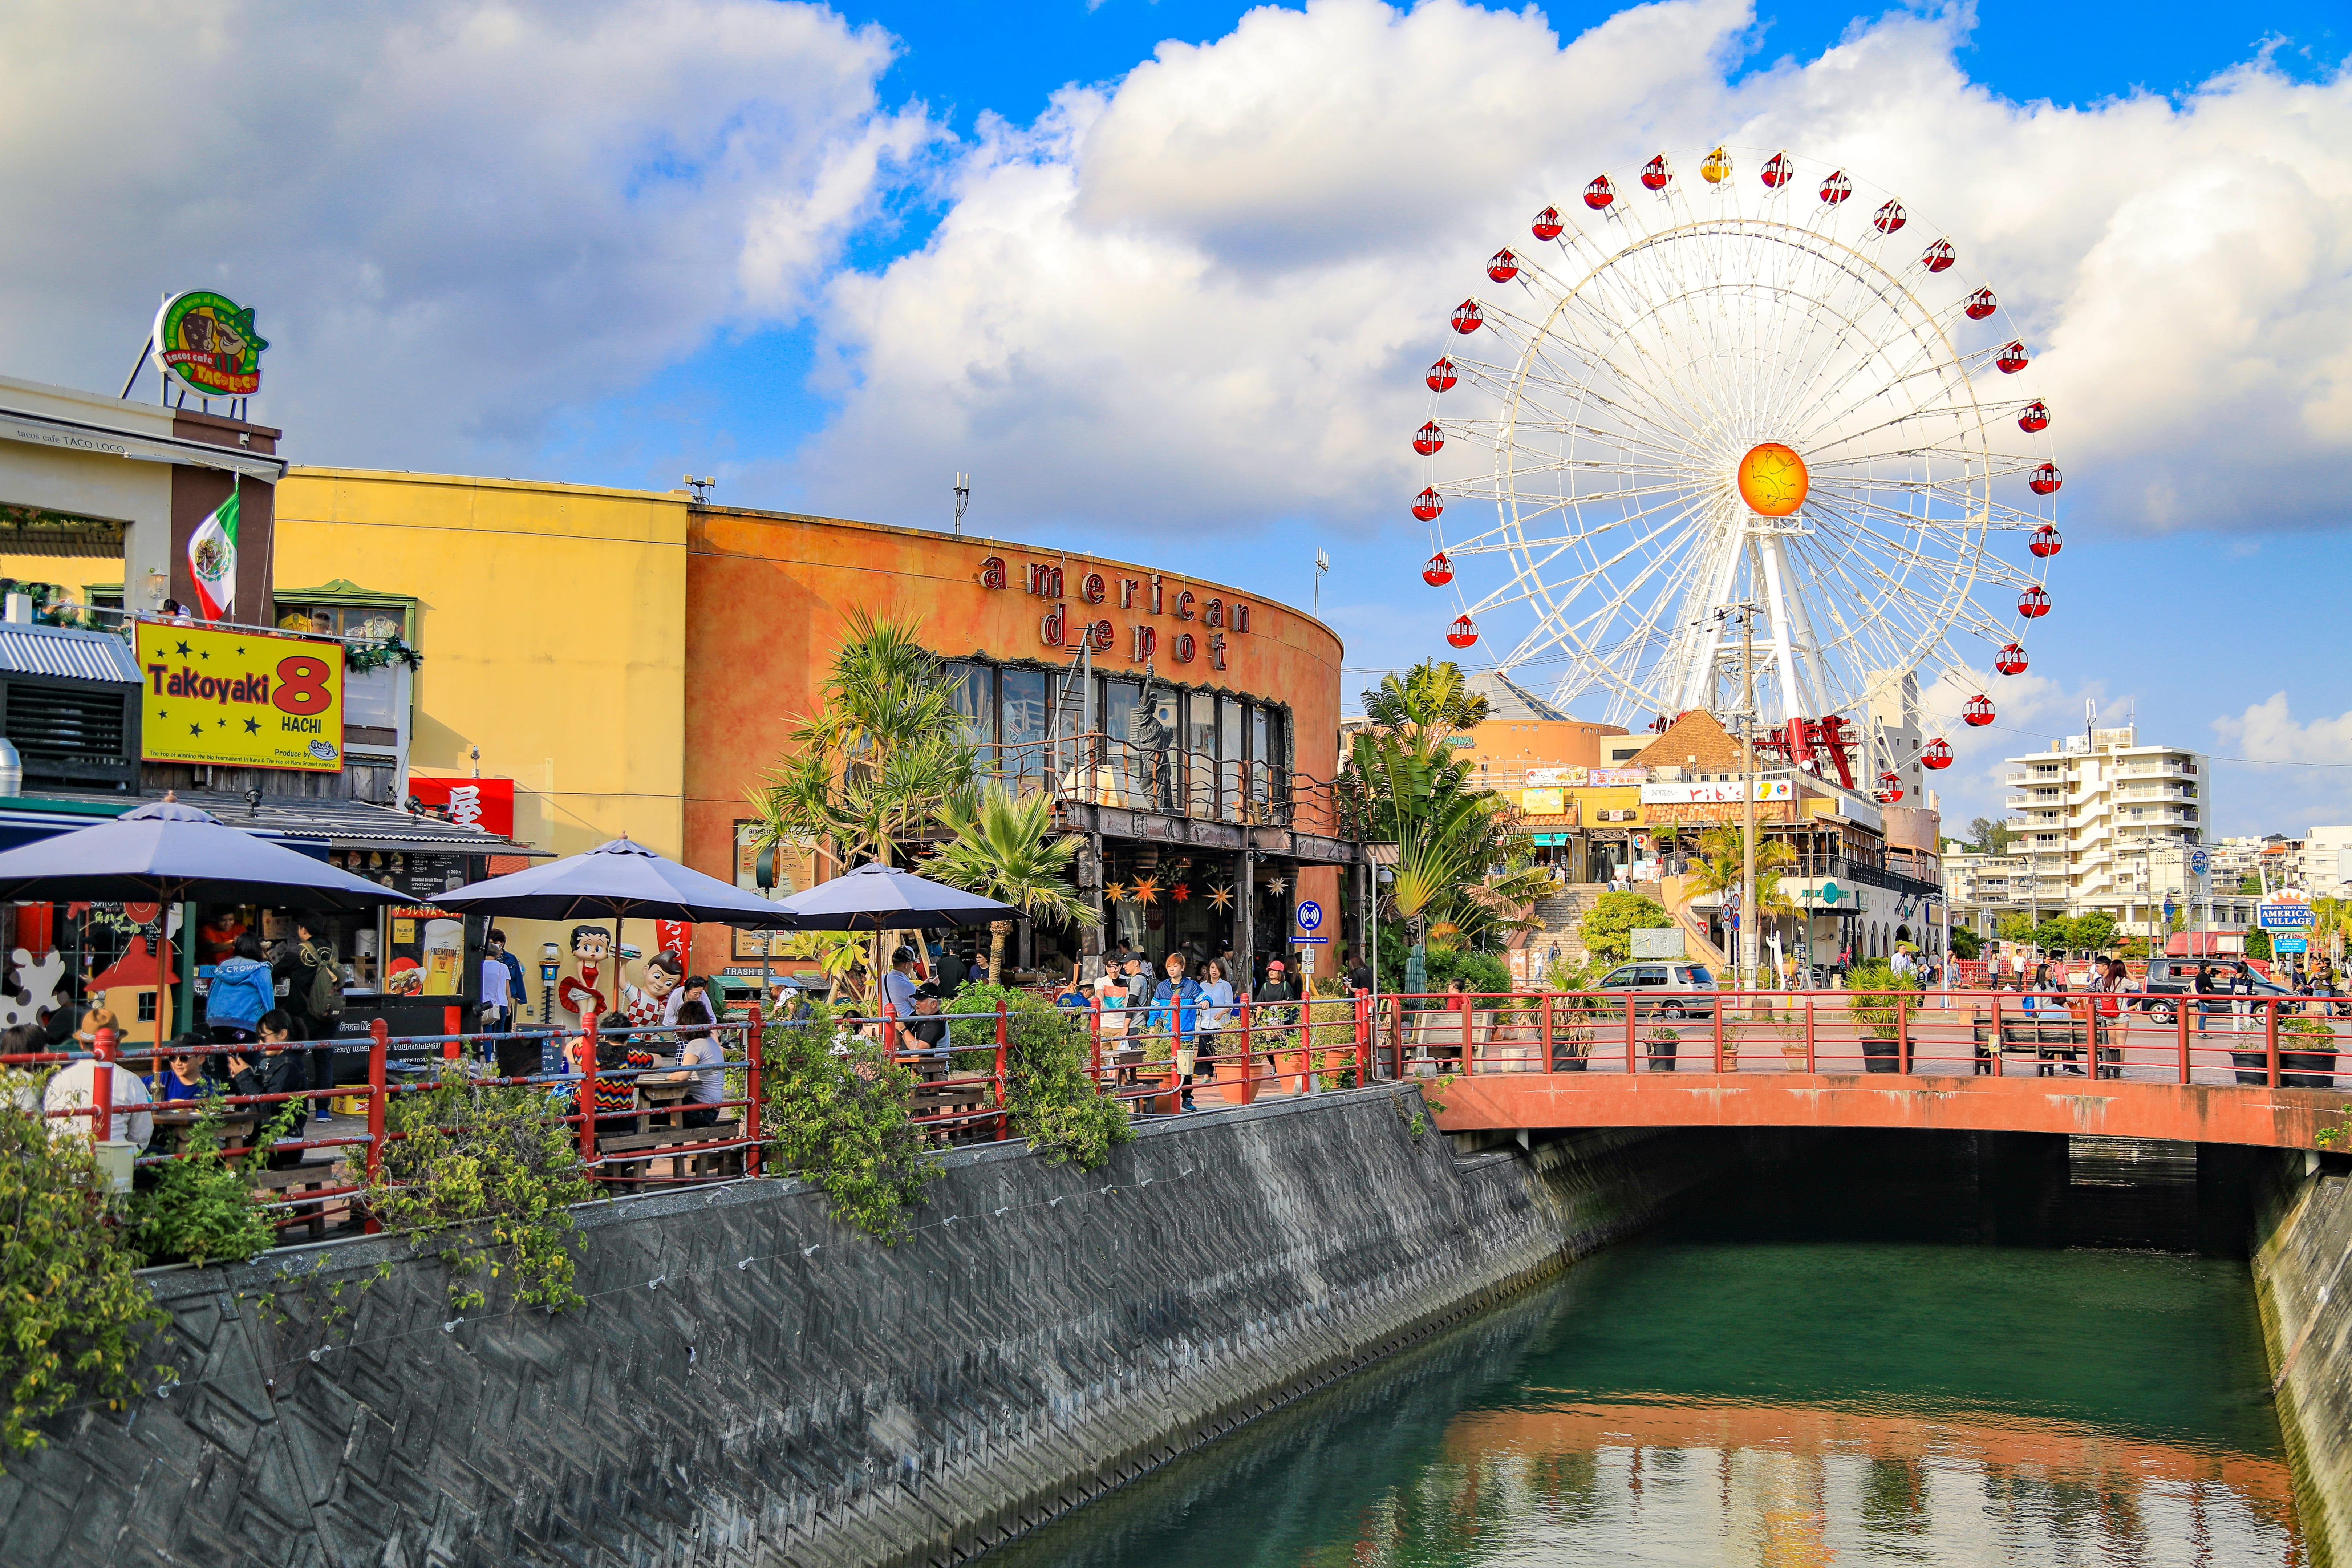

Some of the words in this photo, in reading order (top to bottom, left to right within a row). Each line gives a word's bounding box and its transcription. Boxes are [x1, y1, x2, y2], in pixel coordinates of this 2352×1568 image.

[168, 307, 184, 337] mexican
[183, 297, 201, 308] tacos
[166, 353, 191, 362] tacos
[193, 354, 212, 364] cafe
[18, 430, 40, 439] tacos
[63, 437, 92, 448] TACO
[96, 442, 125, 453] LOCO
[980, 556, 1250, 633] american
[1041, 603, 1227, 671] depot
[148, 663, 270, 705] Takoyaki
[272, 656, 332, 716] 8
[282, 716, 321, 733] HACHI
[275, 749, 301, 757] Produce
[303, 750, 311, 759] by
[1597, 771, 1607, 784] 薬
[448, 785, 485, 831] 屋
[1146, 909, 1164, 920] STOP
[430, 947, 457, 957] PREMIUM
[340, 1021, 359, 1031] from
